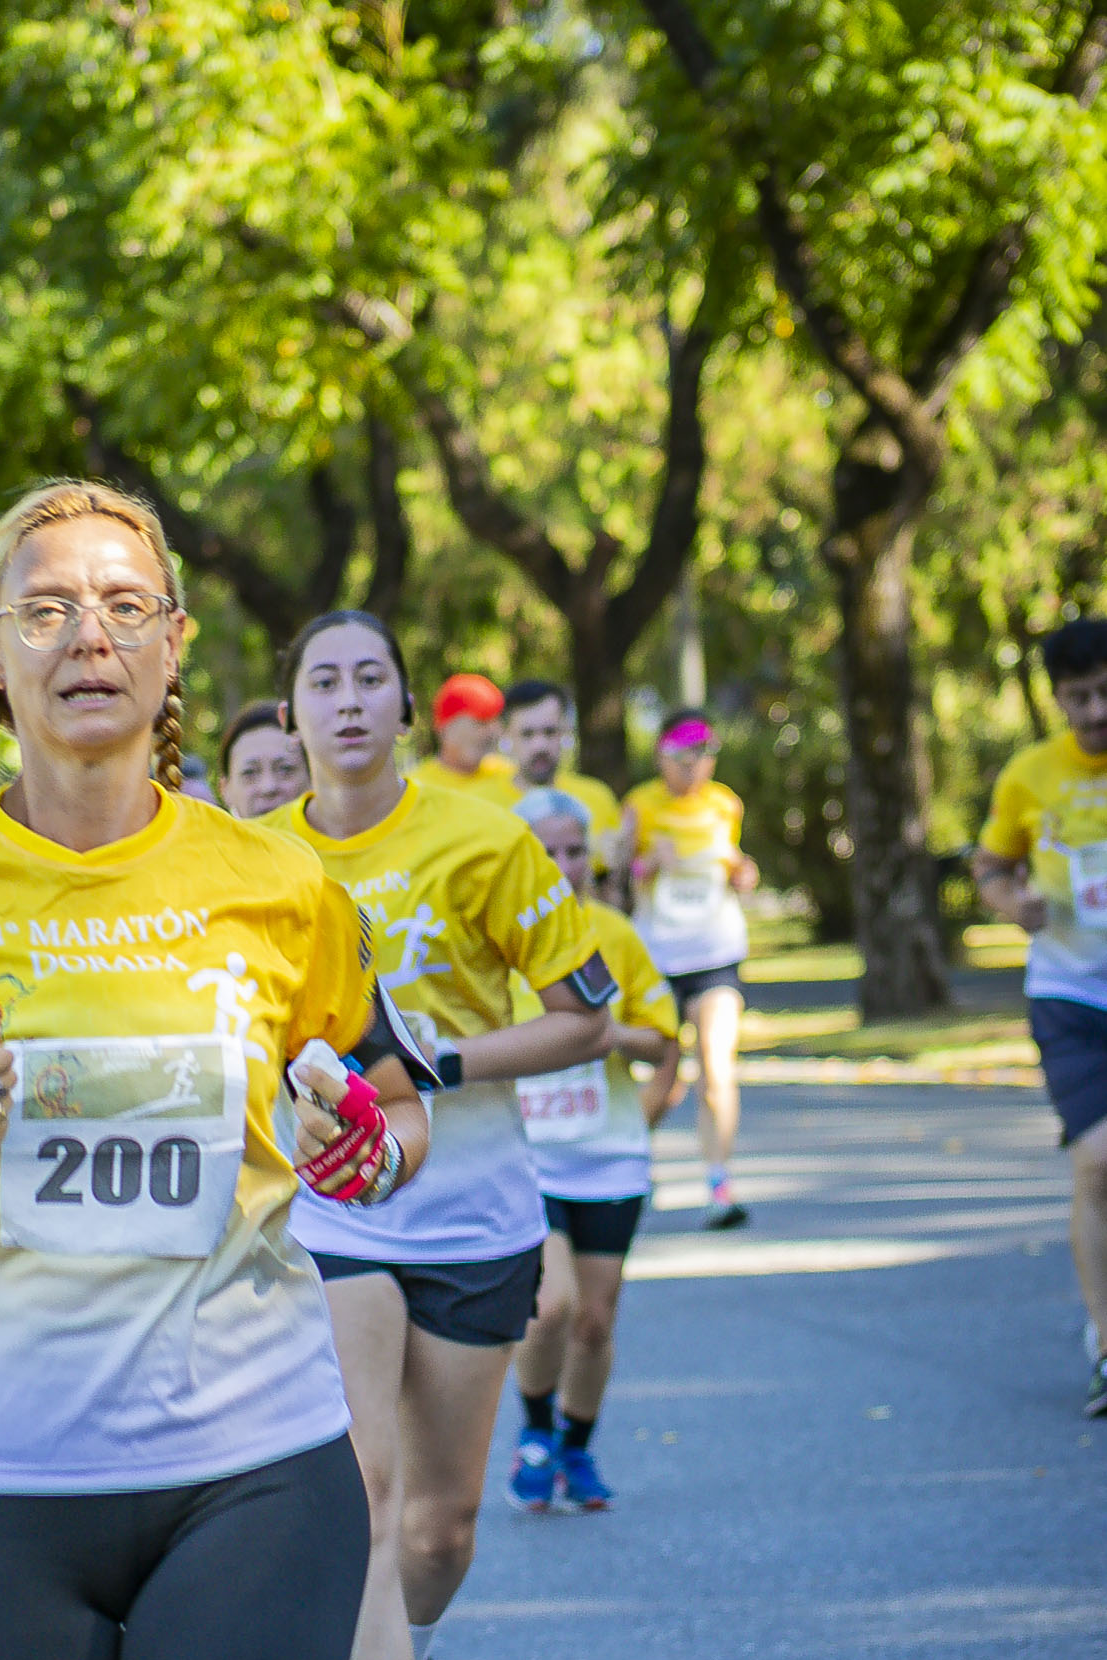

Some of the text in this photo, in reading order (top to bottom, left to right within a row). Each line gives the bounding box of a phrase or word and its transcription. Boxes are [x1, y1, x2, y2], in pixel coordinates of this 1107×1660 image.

[28, 906, 210, 947] MARATÓN
[30, 951, 188, 979] DORADA
[35, 1137, 200, 1207] 200
